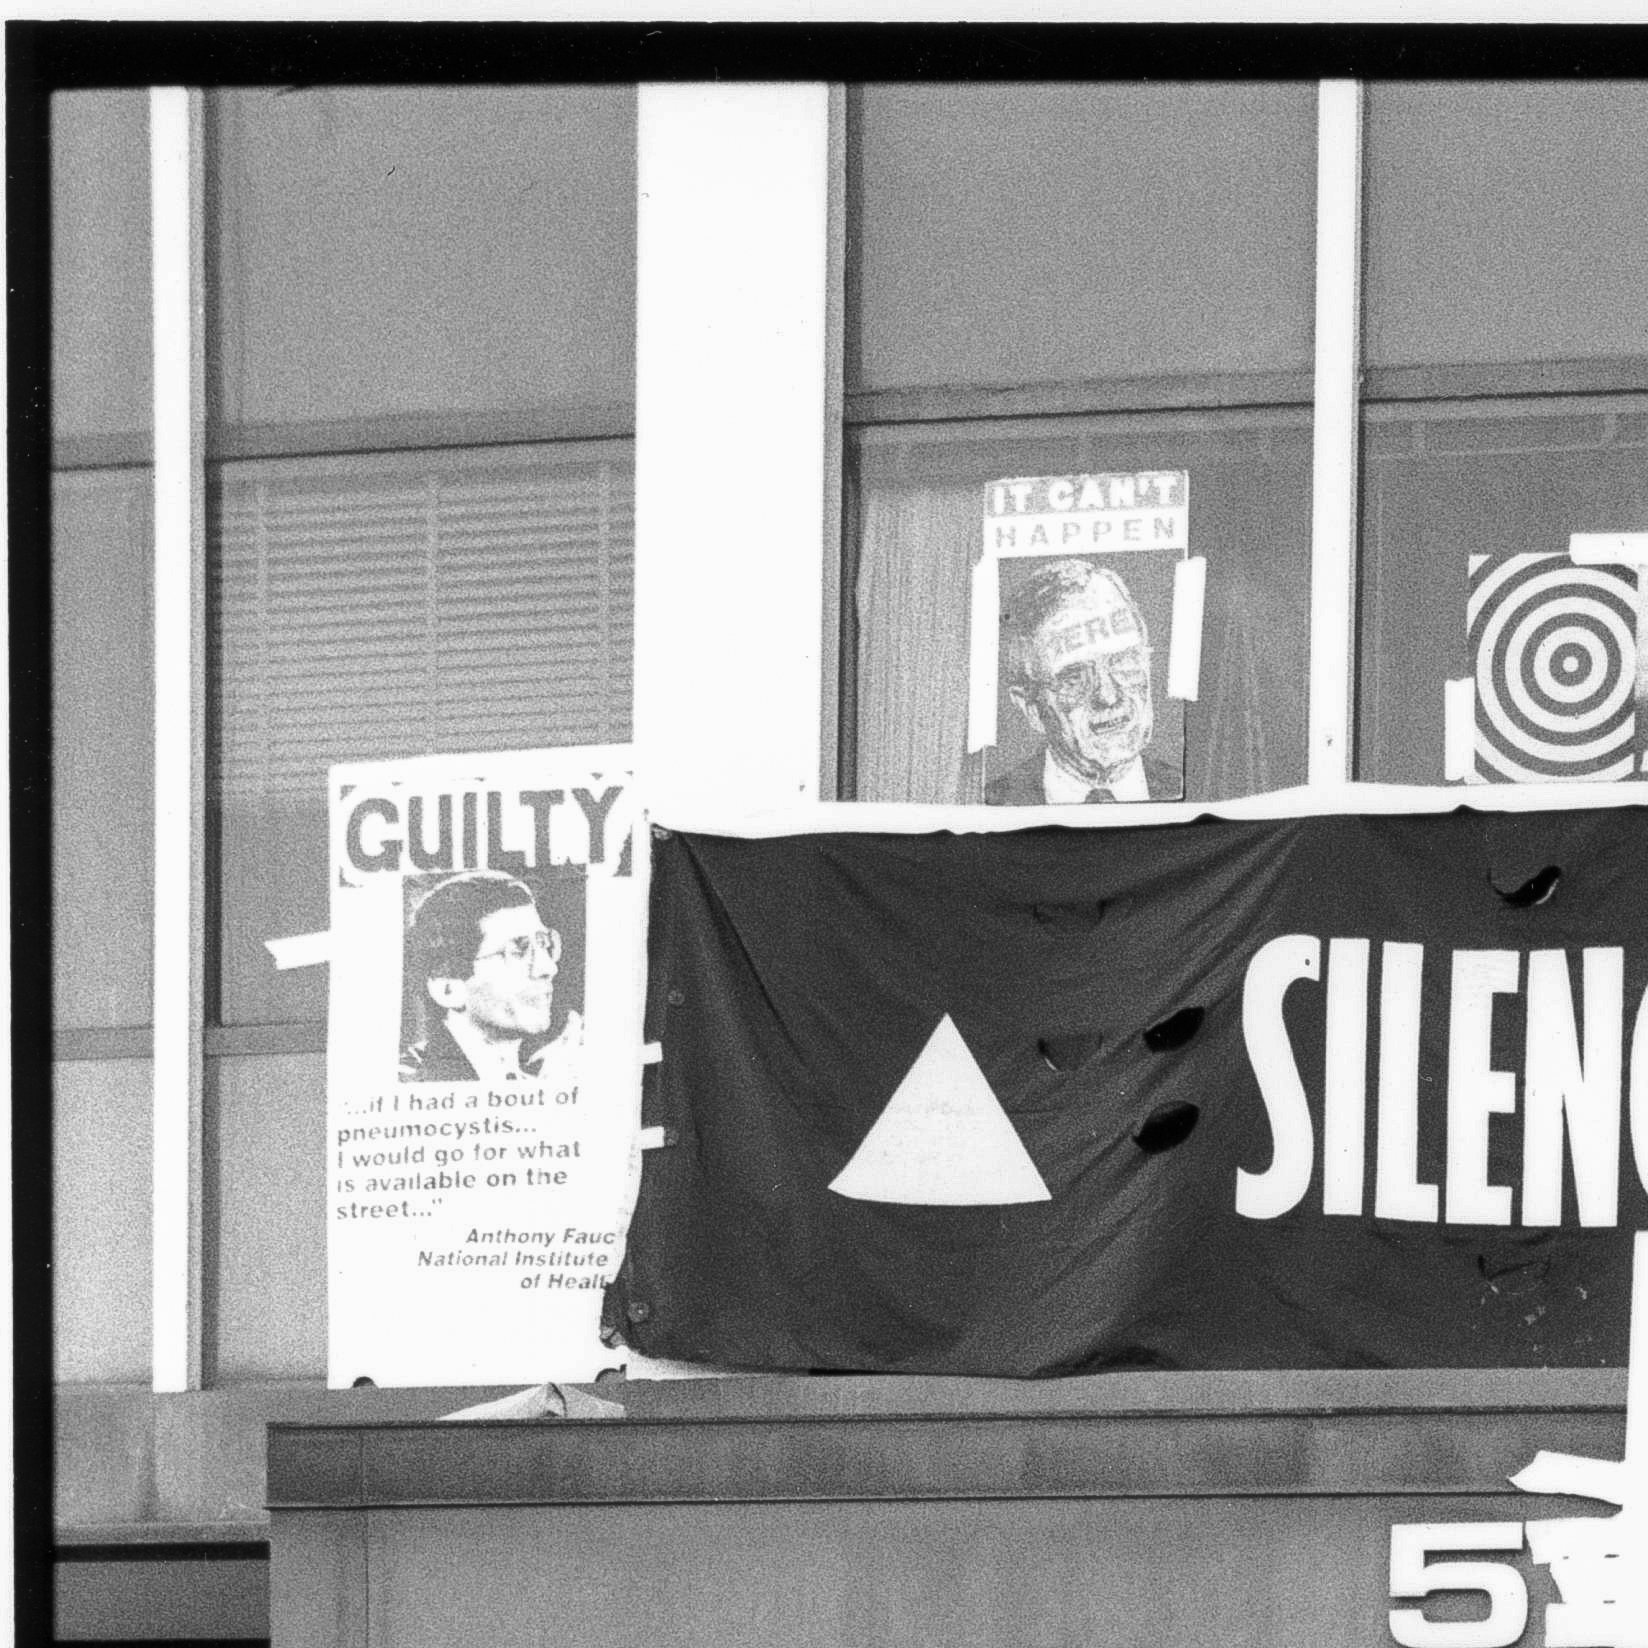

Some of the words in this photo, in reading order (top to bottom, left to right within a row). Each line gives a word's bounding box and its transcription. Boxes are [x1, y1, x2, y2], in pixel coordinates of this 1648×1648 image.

[994, 484, 1033, 514] IT
[1049, 476, 1178, 509] CAN'T
[996, 517, 1175, 548] HAPPEN
[346, 785, 625, 873] GUILTY
[409, 1092, 454, 1111] had
[465, 1095, 478, 1109] a
[488, 1089, 545, 1108] bout
[555, 1086, 579, 1106] of
[338, 1116, 537, 1147] pneumocystis...
[352, 1145, 425, 1168] would
[434, 1148, 464, 1168] go
[474, 1142, 508, 1161] for
[517, 1140, 581, 1160] what
[337, 1179, 355, 1193] is
[365, 1170, 477, 1193] available
[486, 1173, 517, 1188] on
[527, 1167, 568, 1186] the
[466, 1228, 556, 1248] Anthony
[562, 1228, 616, 1245] Fauc
[417, 1249, 508, 1268] National
[515, 1250, 609, 1267] Institute
[520, 1273, 541, 1290] of
[548, 1273, 608, 1290] Healt
